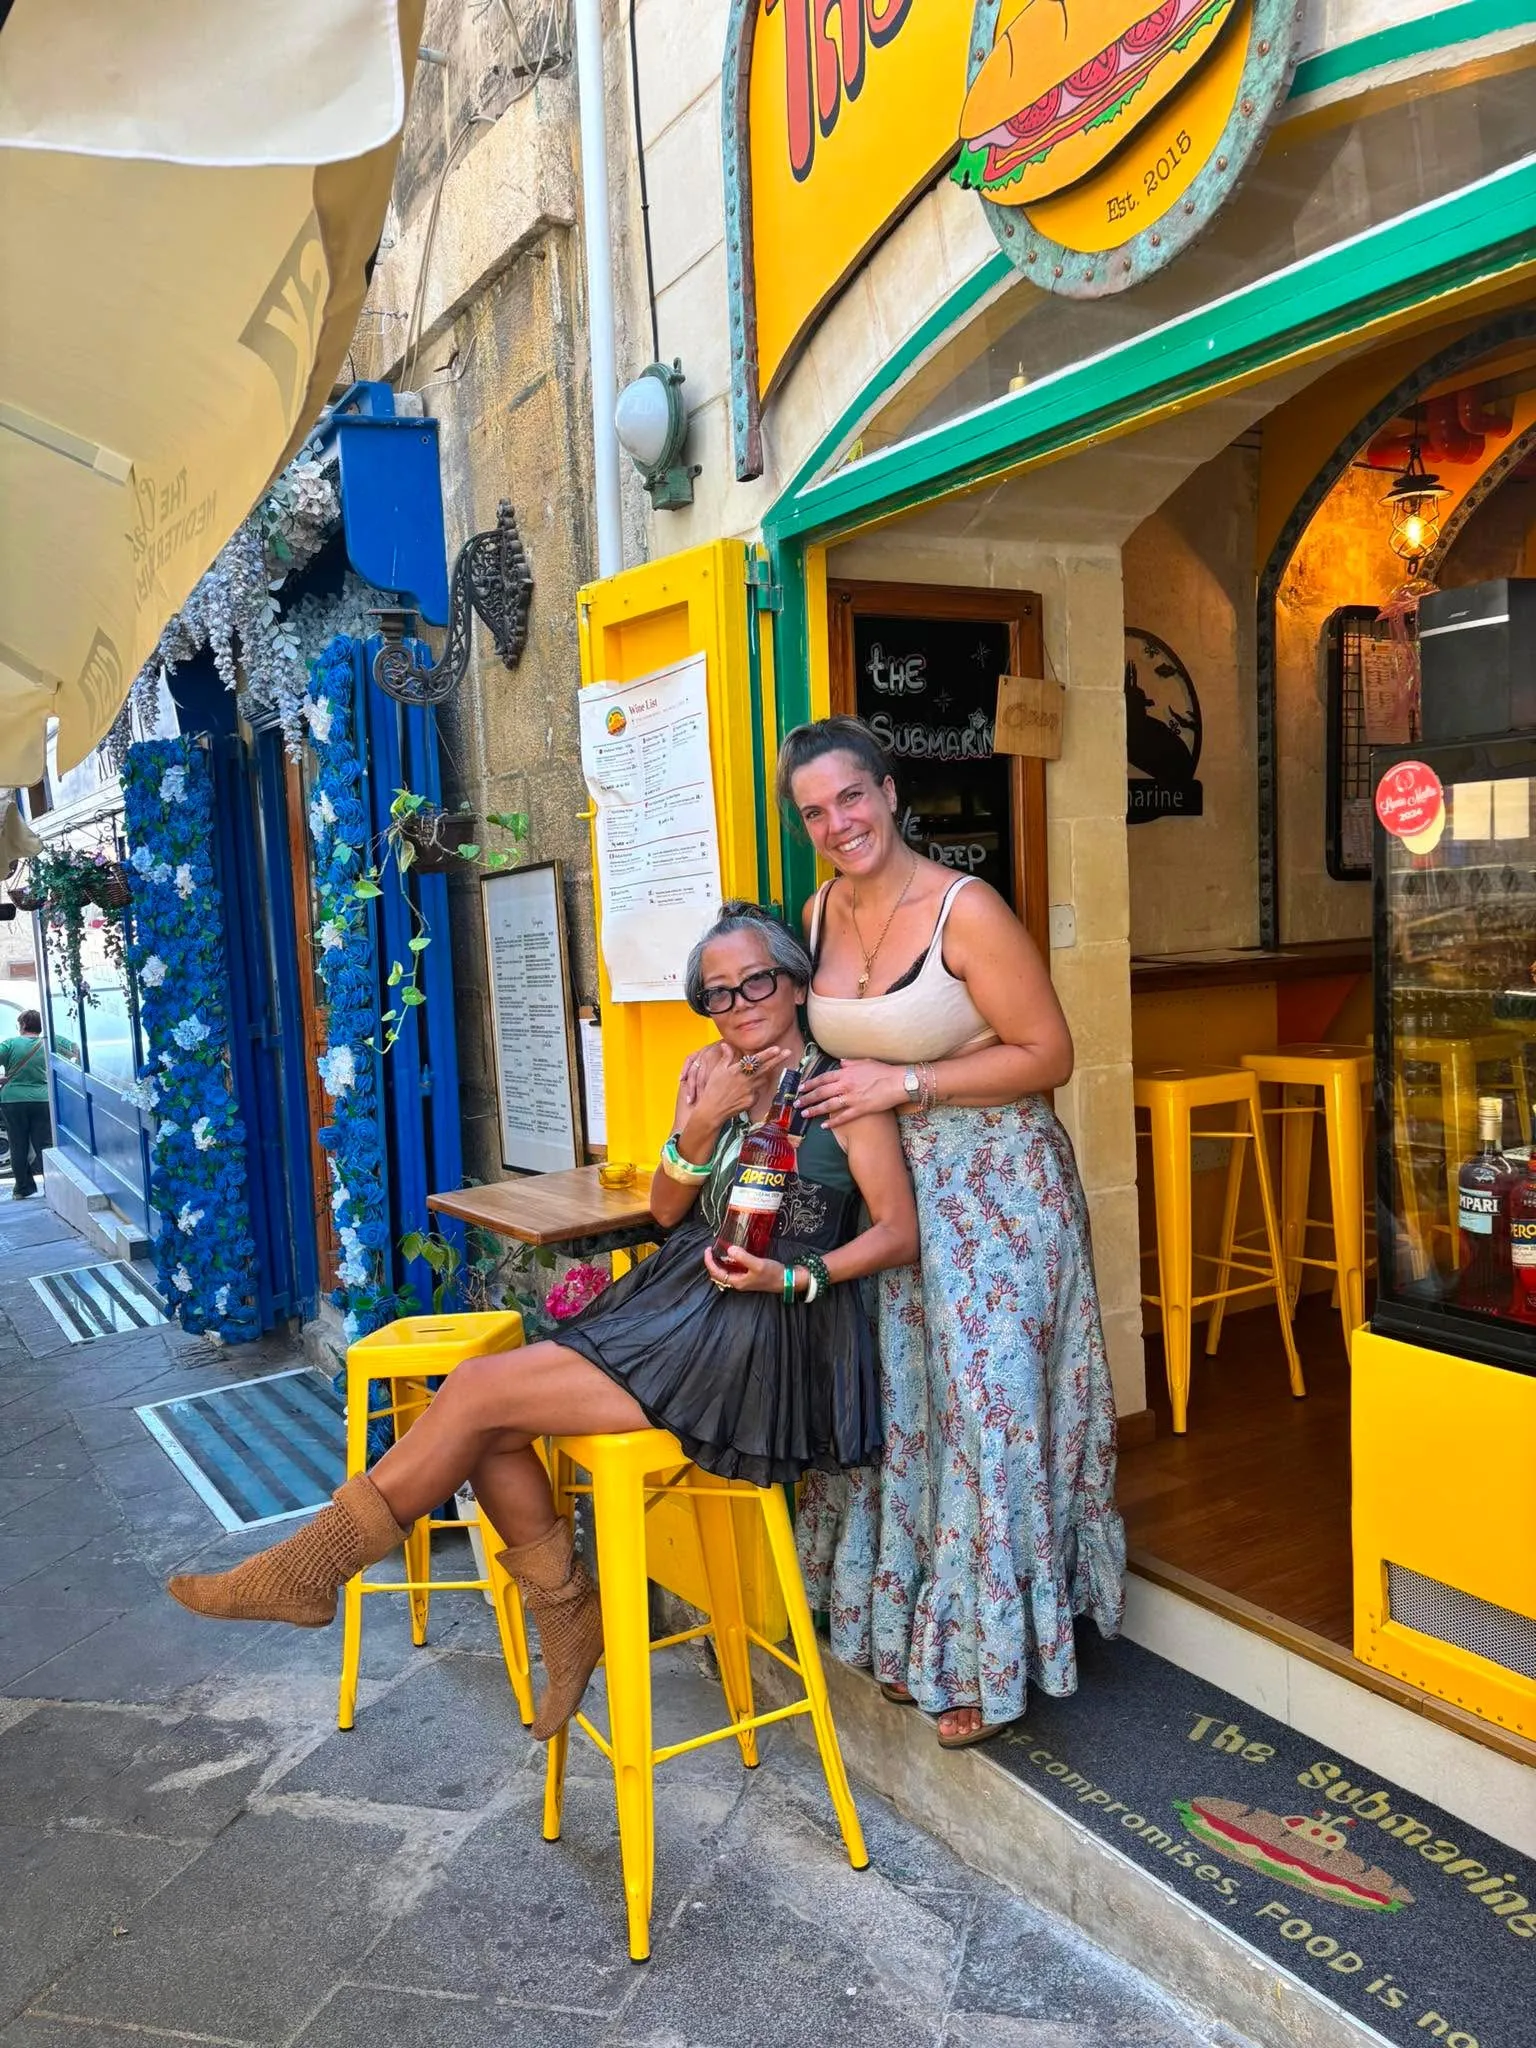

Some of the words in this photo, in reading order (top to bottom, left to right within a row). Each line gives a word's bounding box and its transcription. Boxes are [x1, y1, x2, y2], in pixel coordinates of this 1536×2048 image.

[1106, 191, 1140, 223] Est.
[1143, 129, 1192, 197] 2015
[738, 1168, 786, 1187] APEROL
[1511, 1223, 1536, 1239] ERO
[1186, 1711, 1275, 1763] The
[1296, 1762, 1536, 1938] Submarine
[1029, 1750, 1241, 1906] compromises,
[1255, 1901, 1364, 1974] FOOD
[1365, 1974, 1409, 2008] is
